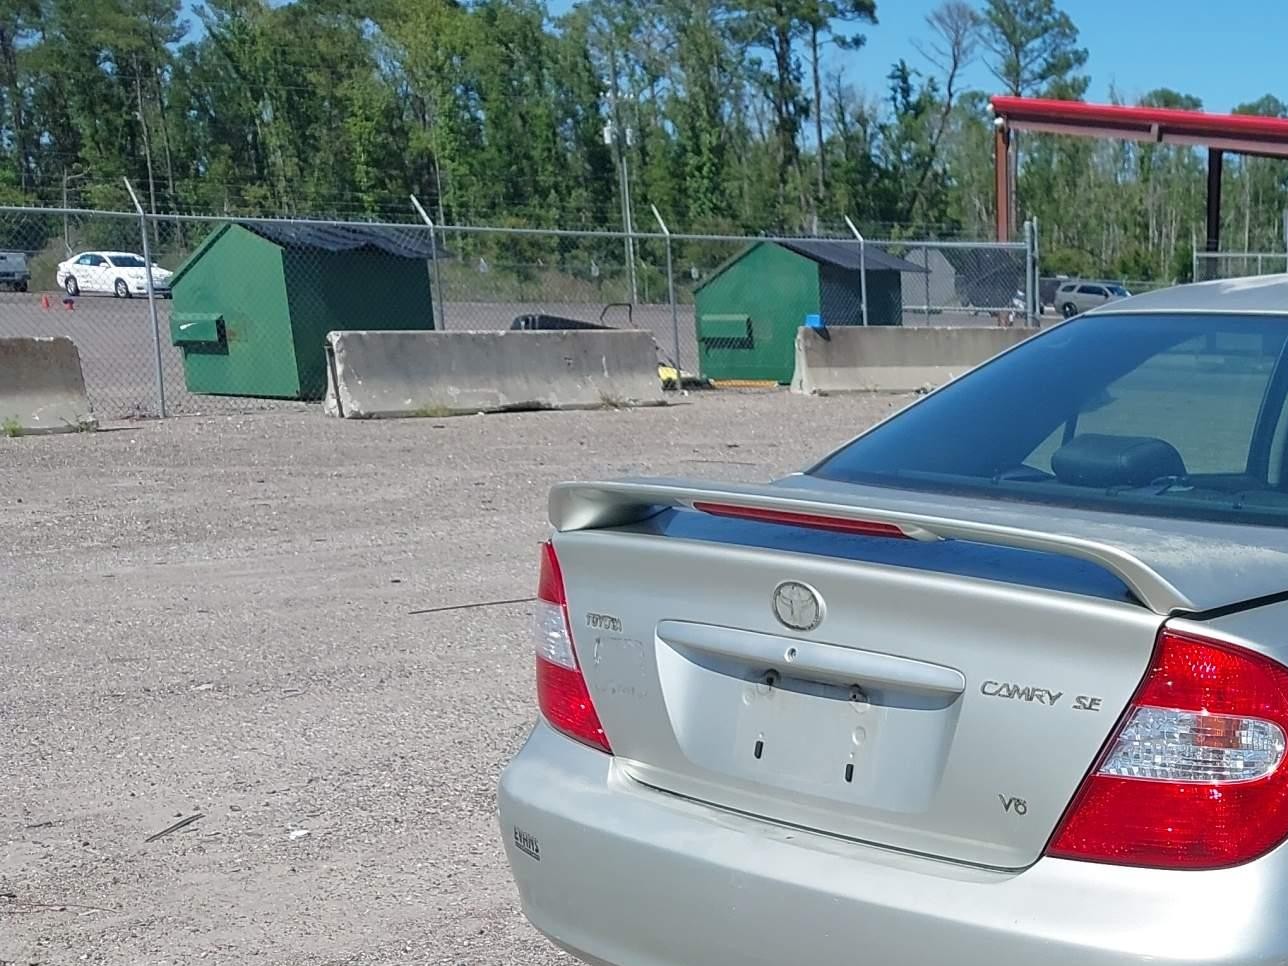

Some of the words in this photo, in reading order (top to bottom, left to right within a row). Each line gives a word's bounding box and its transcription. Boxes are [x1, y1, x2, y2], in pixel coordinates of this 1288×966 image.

[586, 612, 623, 632] TOYOTA
[980, 680, 1063, 706] CAMRY
[1072, 695, 1102, 712] SE
[999, 793, 1027, 815] V6
[513, 825, 539, 853] EVANS
